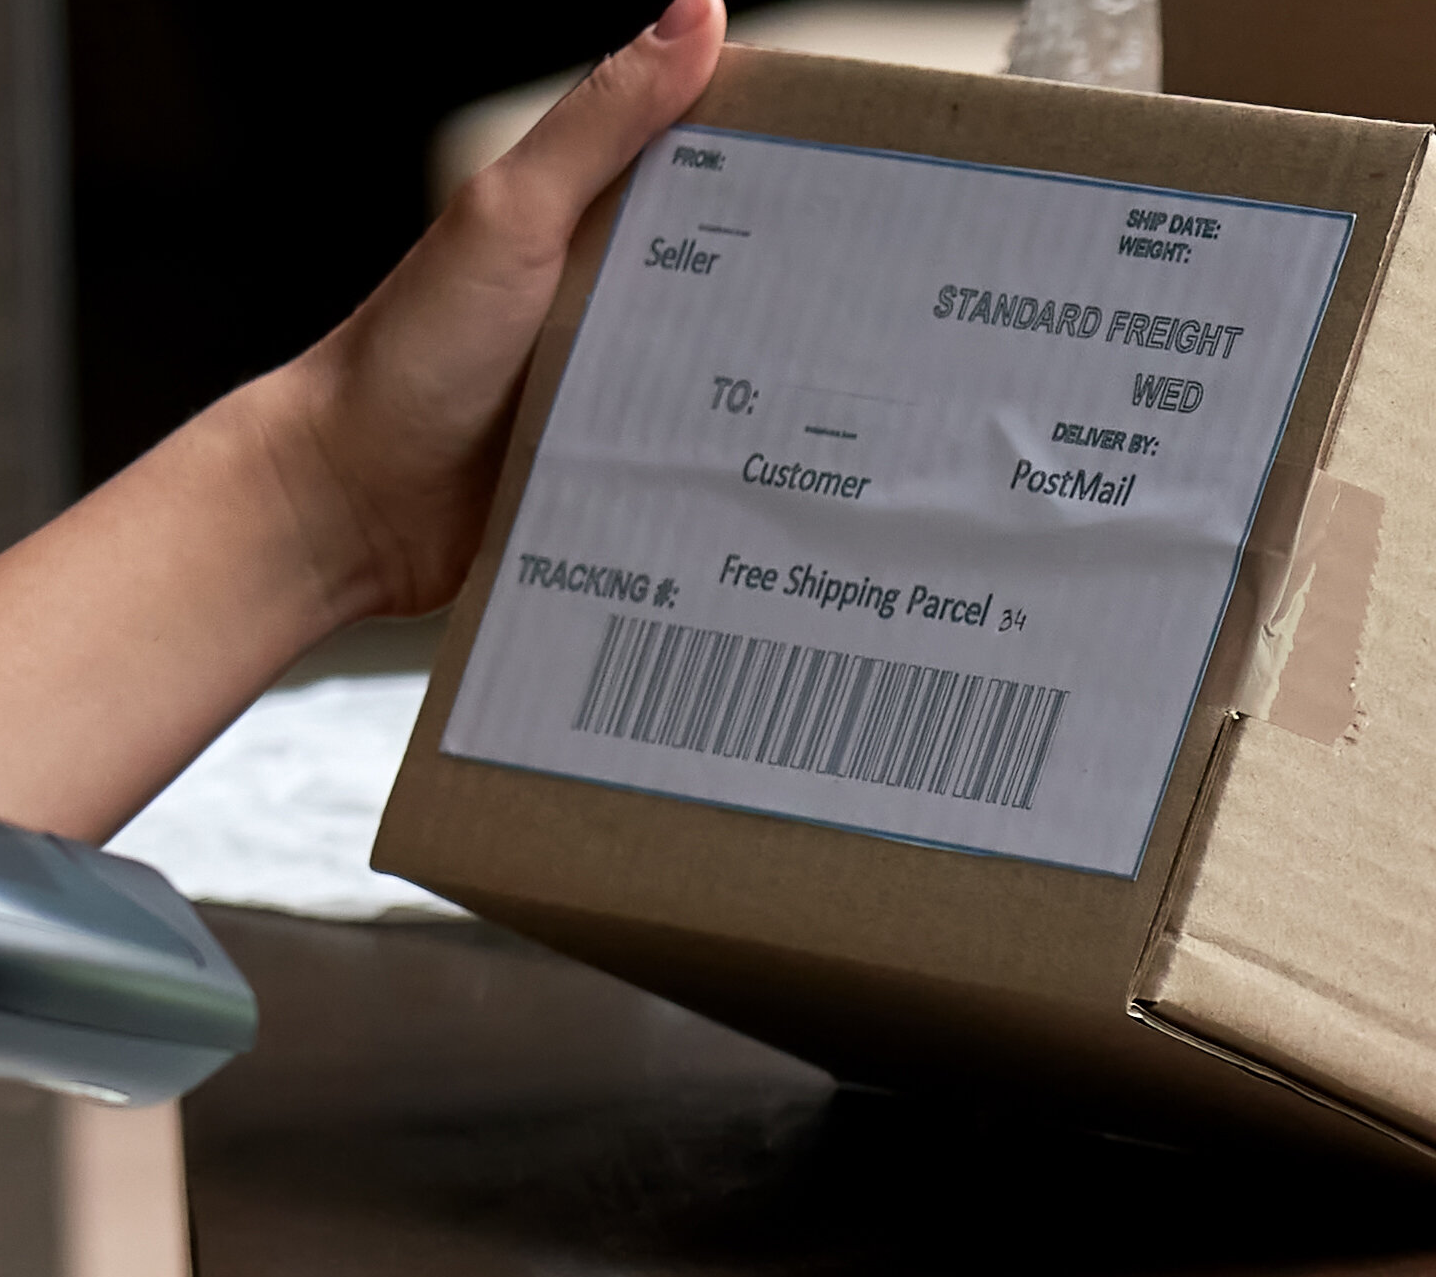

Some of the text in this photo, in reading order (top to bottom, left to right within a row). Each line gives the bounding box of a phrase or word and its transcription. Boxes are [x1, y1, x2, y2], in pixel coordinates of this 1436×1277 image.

[672, 146, 726, 171] FROM:
[1126, 209, 1221, 239] SHIP DATE:
[644, 236, 721, 275] Seller
[1118, 234, 1192, 264] WEIGHT:
[933, 284, 1244, 359] STANDARD FREIGHT
[711, 376, 759, 416] TO:
[1132, 373, 1204, 414] WED
[1051, 422, 1161, 457] DELIVER BY:
[742, 452, 872, 500] Customer
[1010, 459, 1136, 507] PostMail
[518, 553, 651, 603] TRACKING
[719, 553, 994, 627] Free Shipping Parcel
